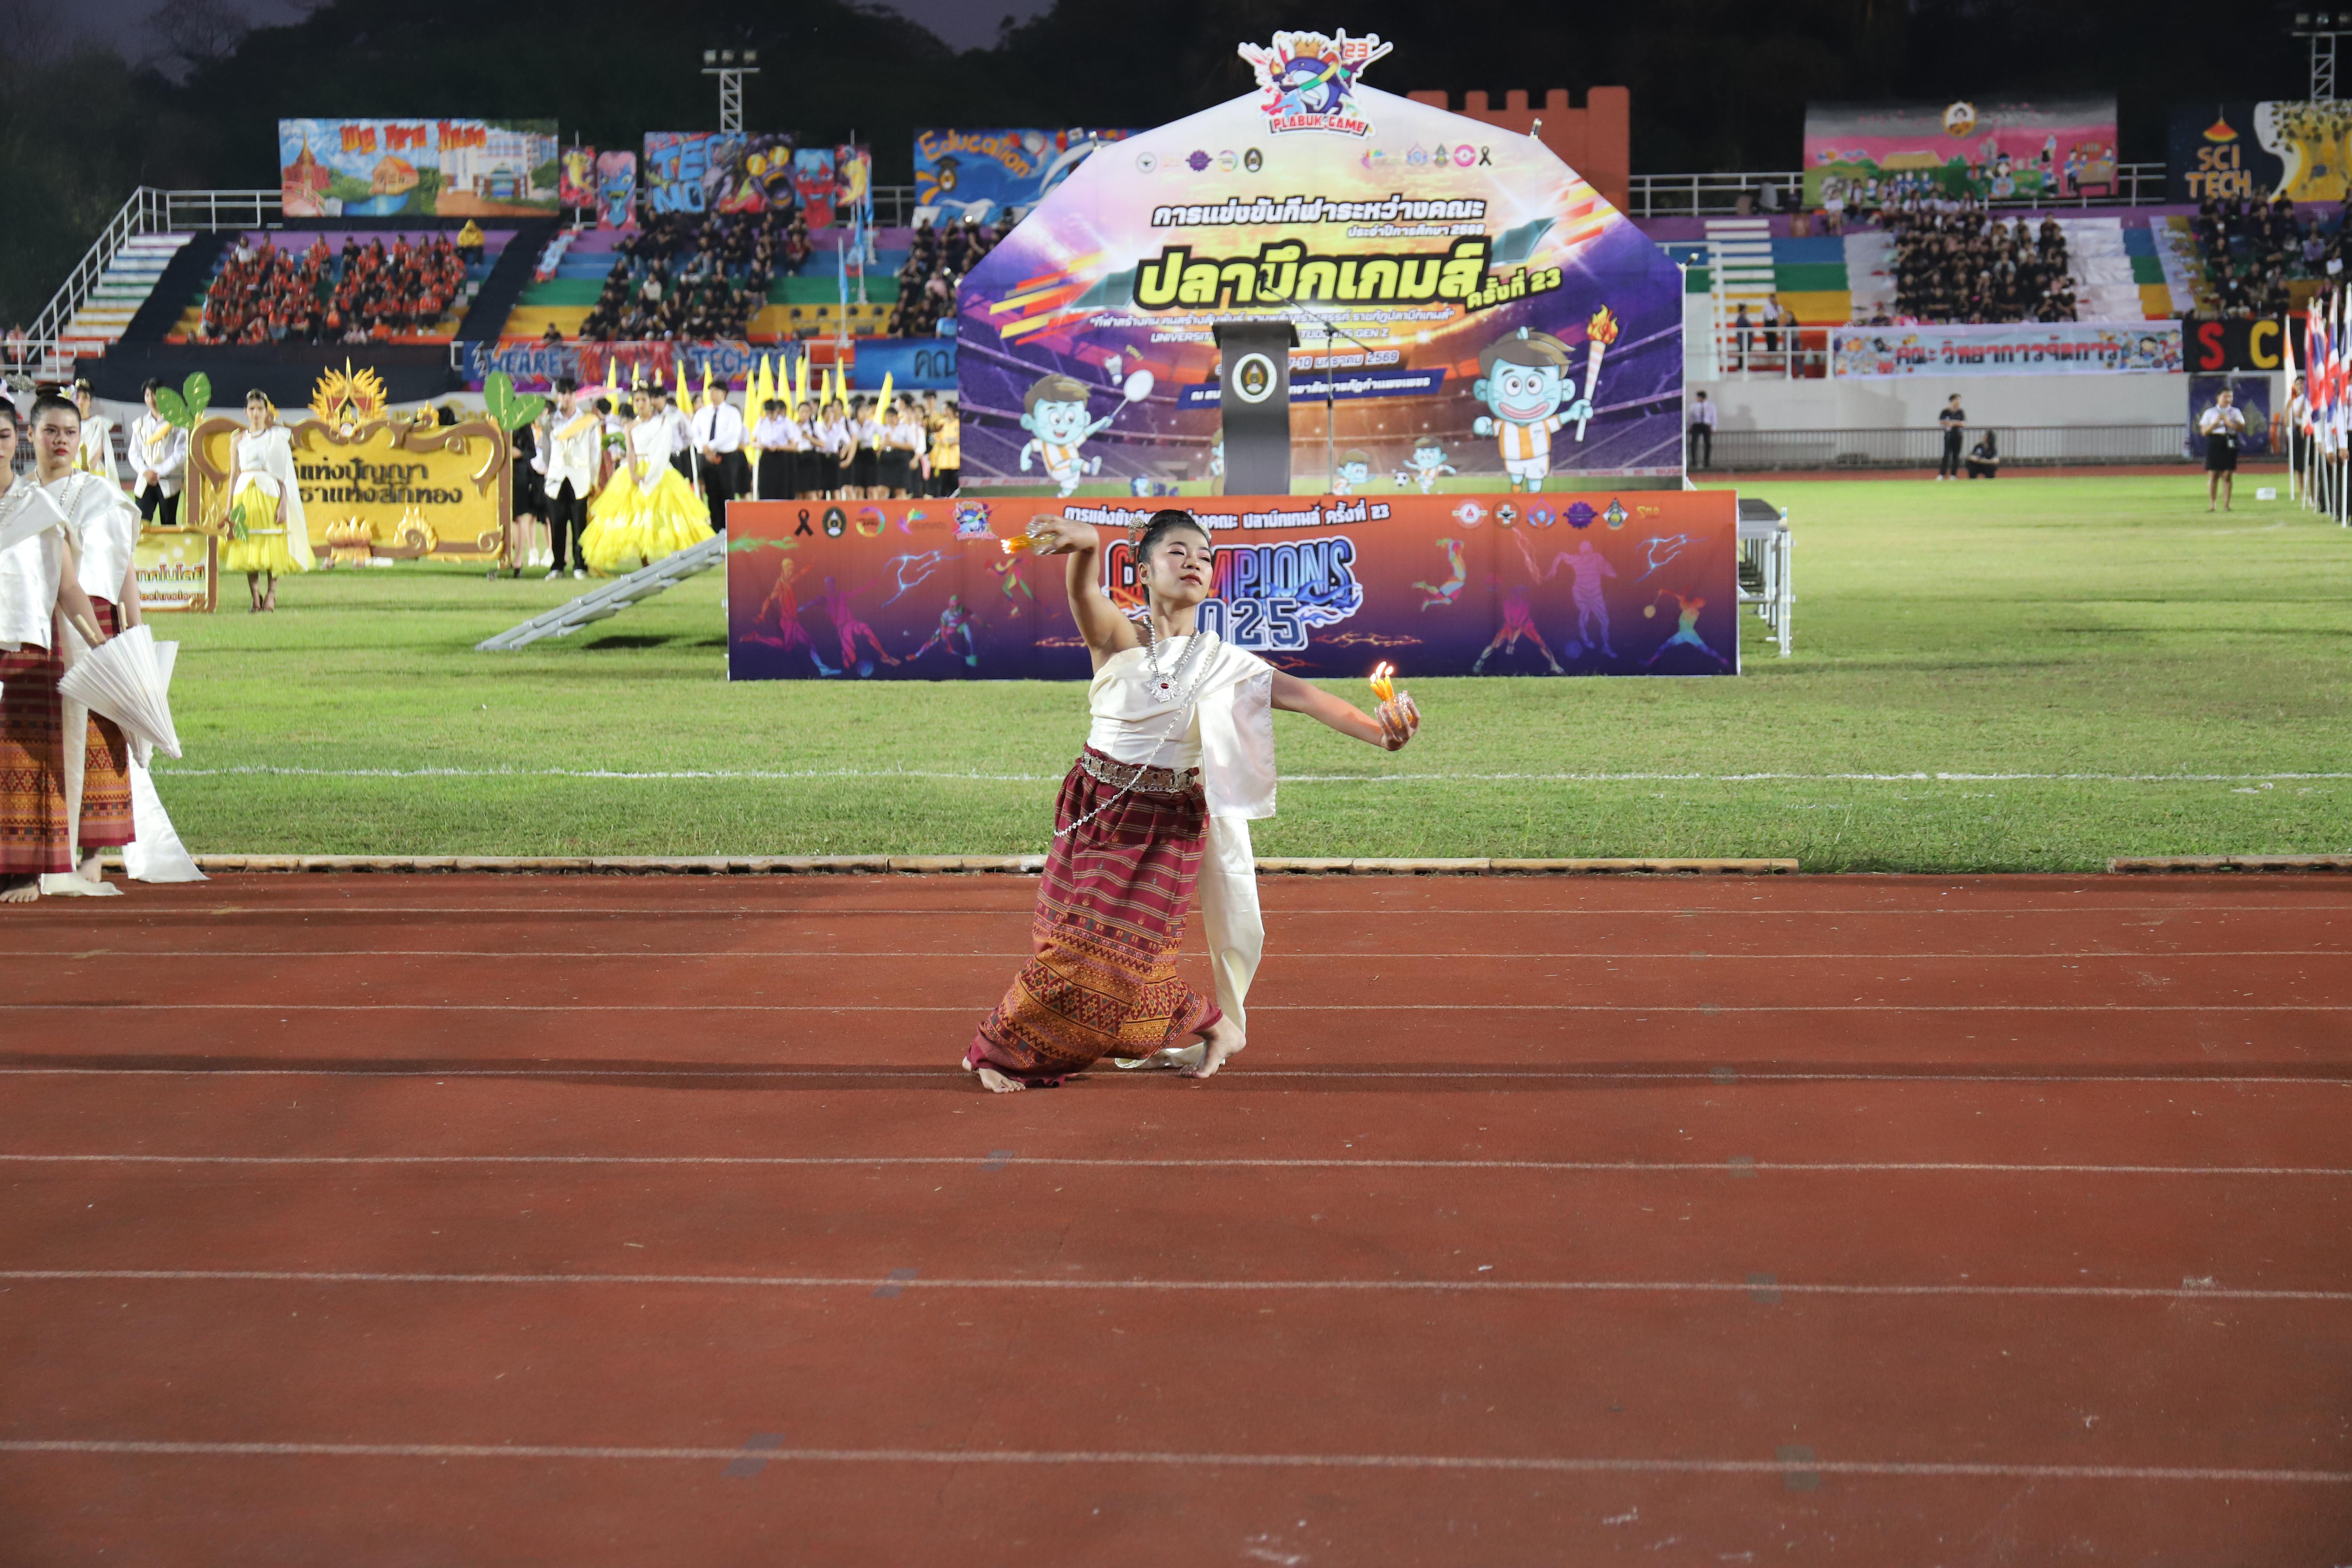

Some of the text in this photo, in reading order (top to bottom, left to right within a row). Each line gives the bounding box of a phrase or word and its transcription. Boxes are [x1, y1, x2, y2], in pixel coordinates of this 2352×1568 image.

[1343, 43, 1369, 58] 23
[1272, 116, 1365, 132] PLABUK GAME
[2197, 144, 2240, 172] SCI
[2185, 169, 2252, 199] TECH
[1152, 194, 1485, 226] การแข่งขันกีฬาระหว่างคณะ
[1348, 224, 1450, 237] ประจำปีการศึกษา
[1135, 240, 1562, 310] ปลาบึกเกมส์ ครั้งที่ 23
[914, 349, 959, 378] คณ
[1314, 354, 1364, 369] มกราคม
[1896, 346, 1937, 364] คณะ
[1242, 506, 1321, 529] ปลาบึกเกมส์
[1325, 499, 1367, 524] ครั้งที่
[1370, 504, 1390, 520] 23
[136, 564, 205, 582] ทคโนโลยี
[1195, 598, 1308, 651] 025
